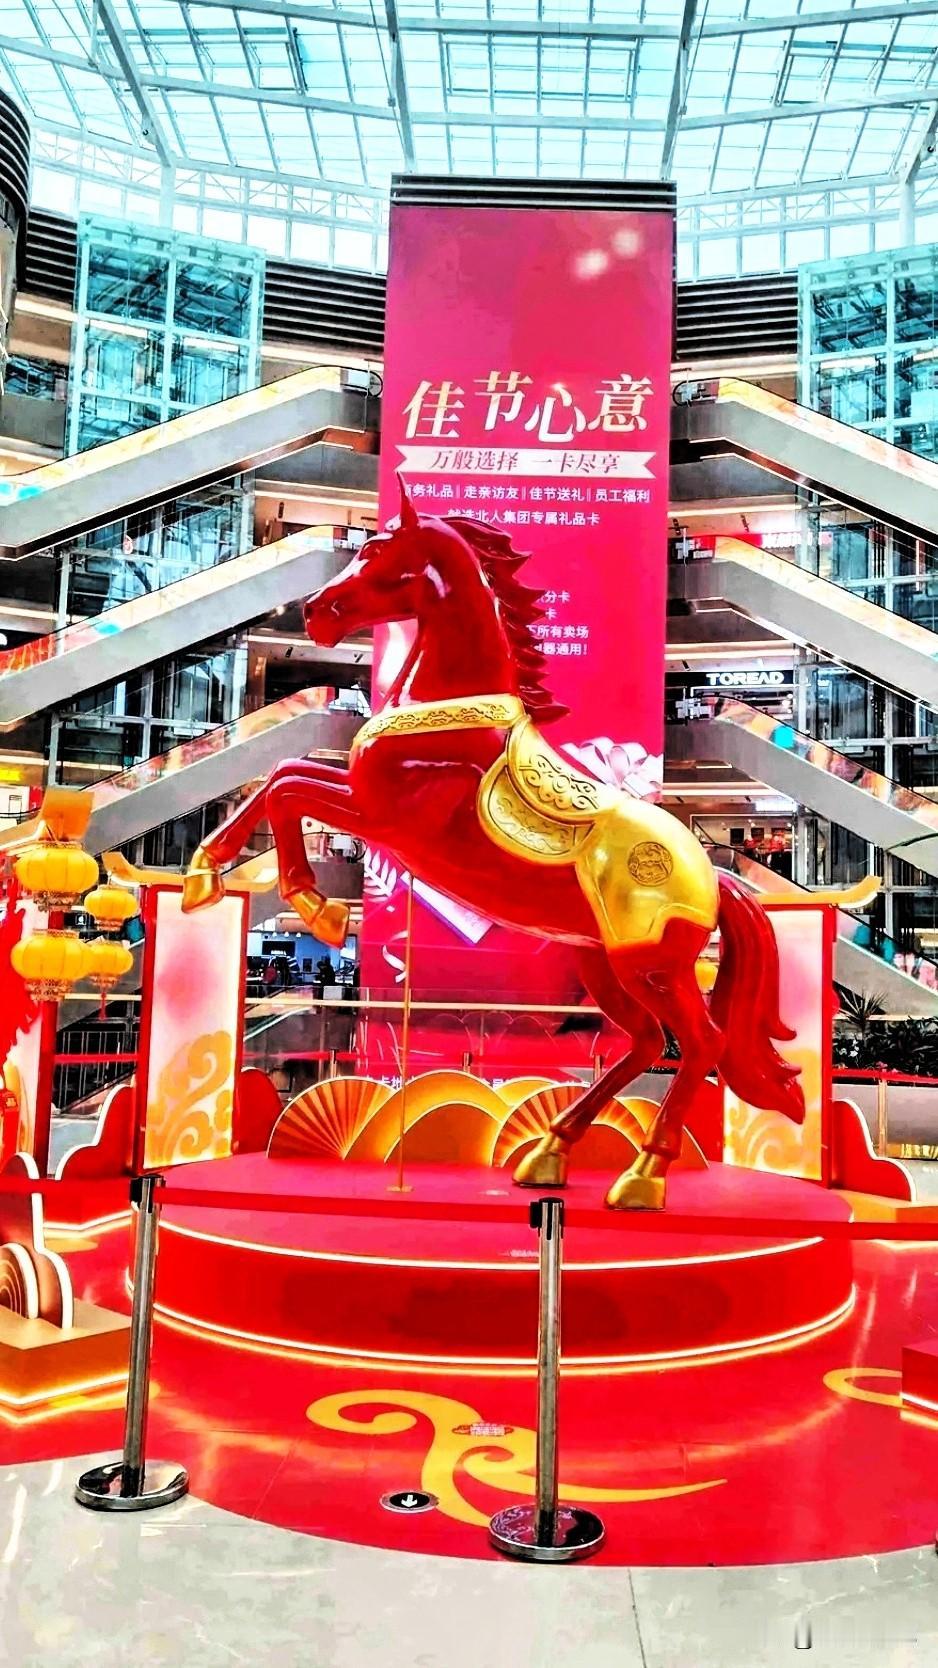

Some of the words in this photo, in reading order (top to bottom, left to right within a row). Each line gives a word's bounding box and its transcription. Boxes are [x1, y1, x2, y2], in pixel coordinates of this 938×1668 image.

[402, 371, 654, 443] 佳节心意
[430, 450, 519, 472] 万般选择
[531, 452, 620, 474] 一卡尽享
[464, 485, 519, 499] 走亲访友
[529, 487, 586, 502] 佳节送礼
[595, 489, 650, 504] 员工福利
[537, 590, 571, 603] 分卡
[706, 671, 785, 686] TOREAD
